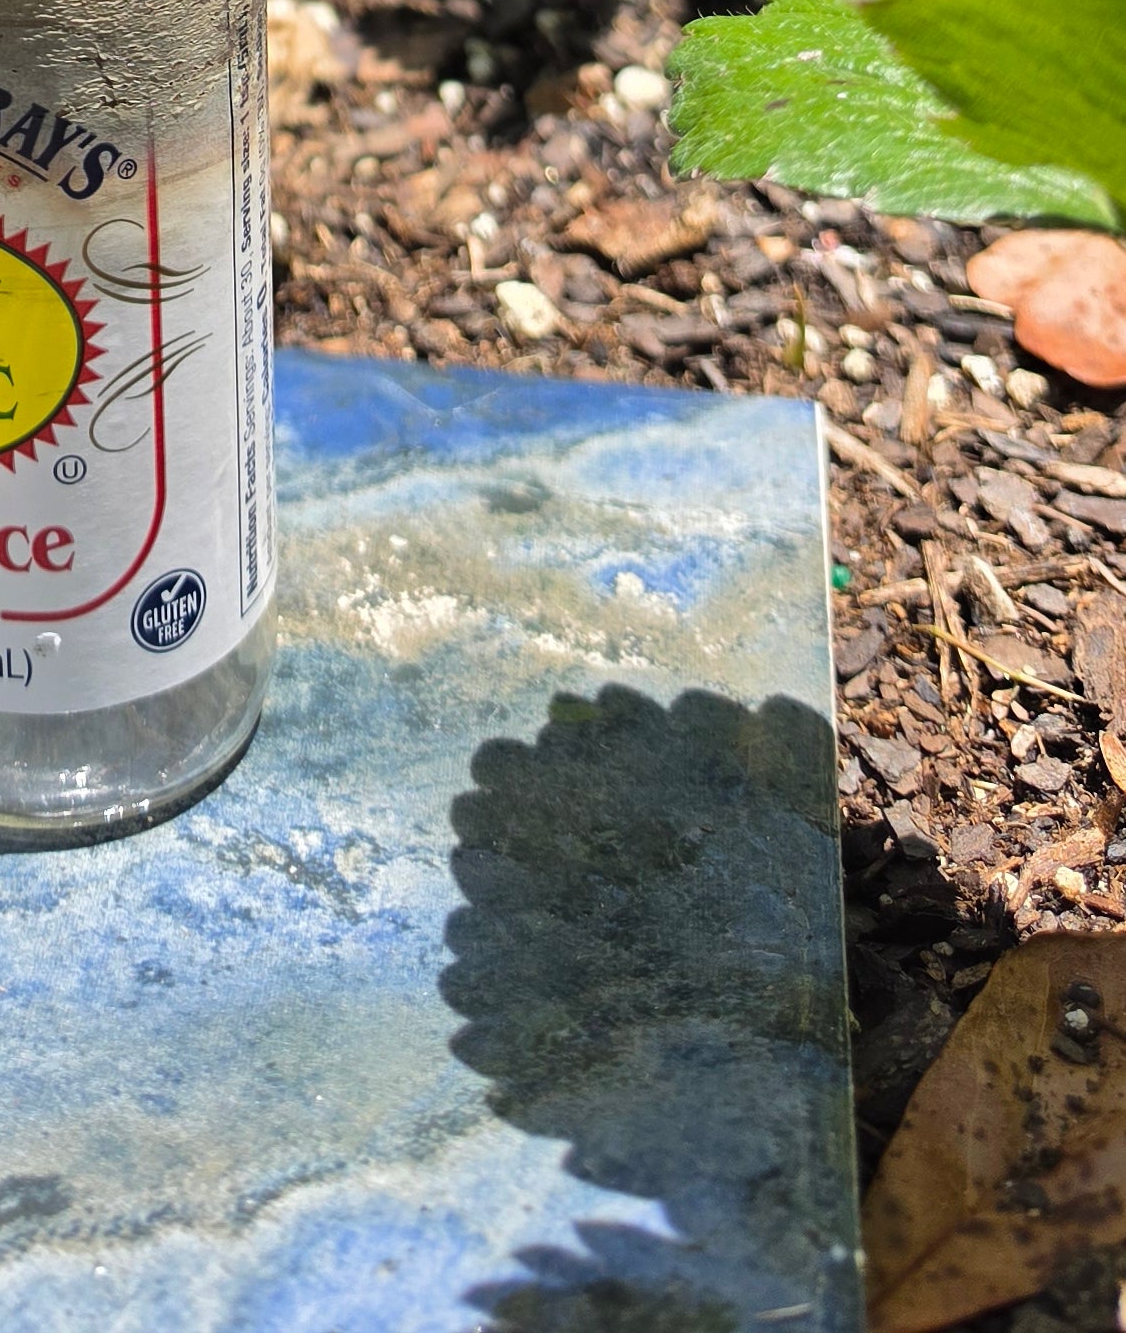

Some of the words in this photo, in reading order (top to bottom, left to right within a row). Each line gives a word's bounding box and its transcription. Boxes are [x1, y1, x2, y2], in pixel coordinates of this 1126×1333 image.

[241, 292, 254, 347] About
[244, 440, 256, 504] Facts
[245, 502, 258, 598] Nutrition
[142, 591, 198, 630] GLUTEN
[158, 620, 185, 644] FREE
